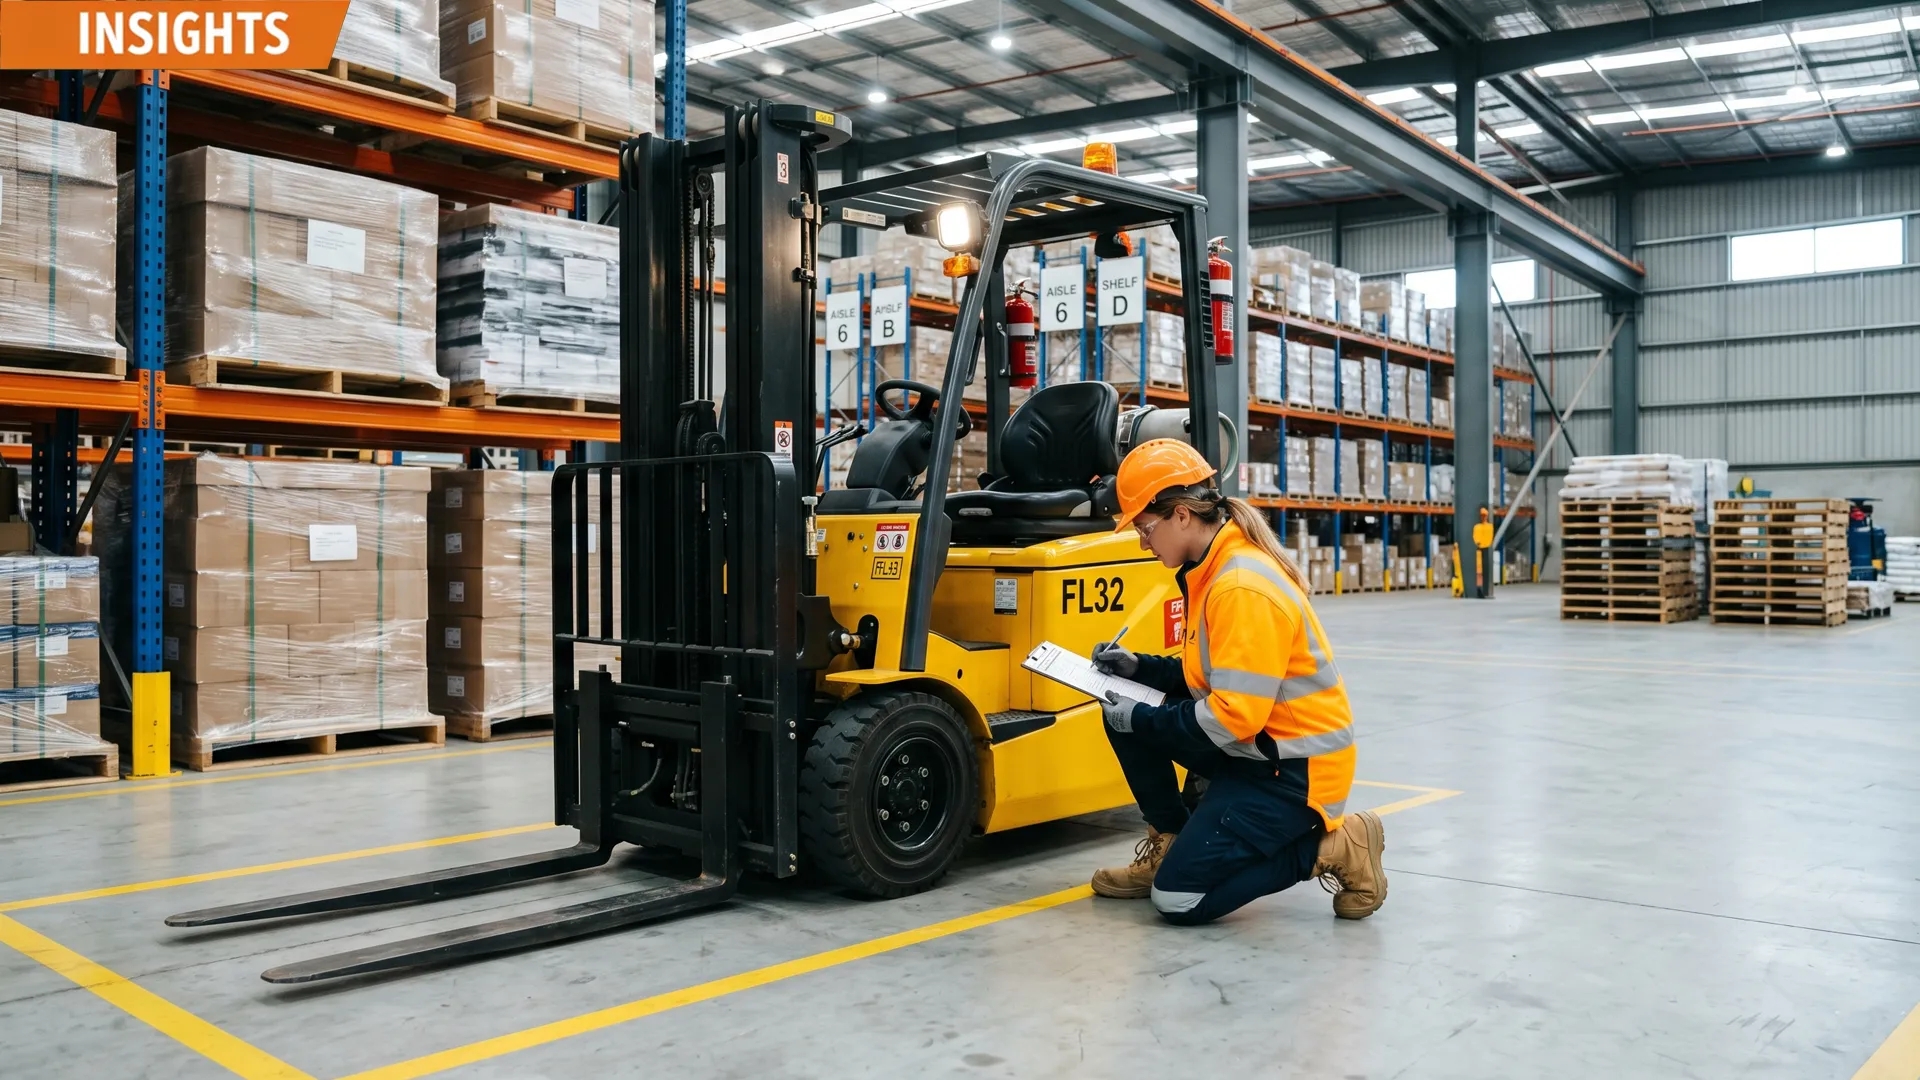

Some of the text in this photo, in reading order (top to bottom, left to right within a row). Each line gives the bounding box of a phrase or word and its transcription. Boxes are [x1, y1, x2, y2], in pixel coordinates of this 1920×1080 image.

[1046, 284, 1077, 297] AISLE
[1102, 276, 1138, 291] SHELF
[830, 308, 856, 320] AISLE
[1056, 302, 1068, 323] 6
[1113, 295, 1128, 316] D
[838, 324, 848, 343] 6
[883, 319, 895, 338] B
[1062, 576, 1124, 614] FL32
